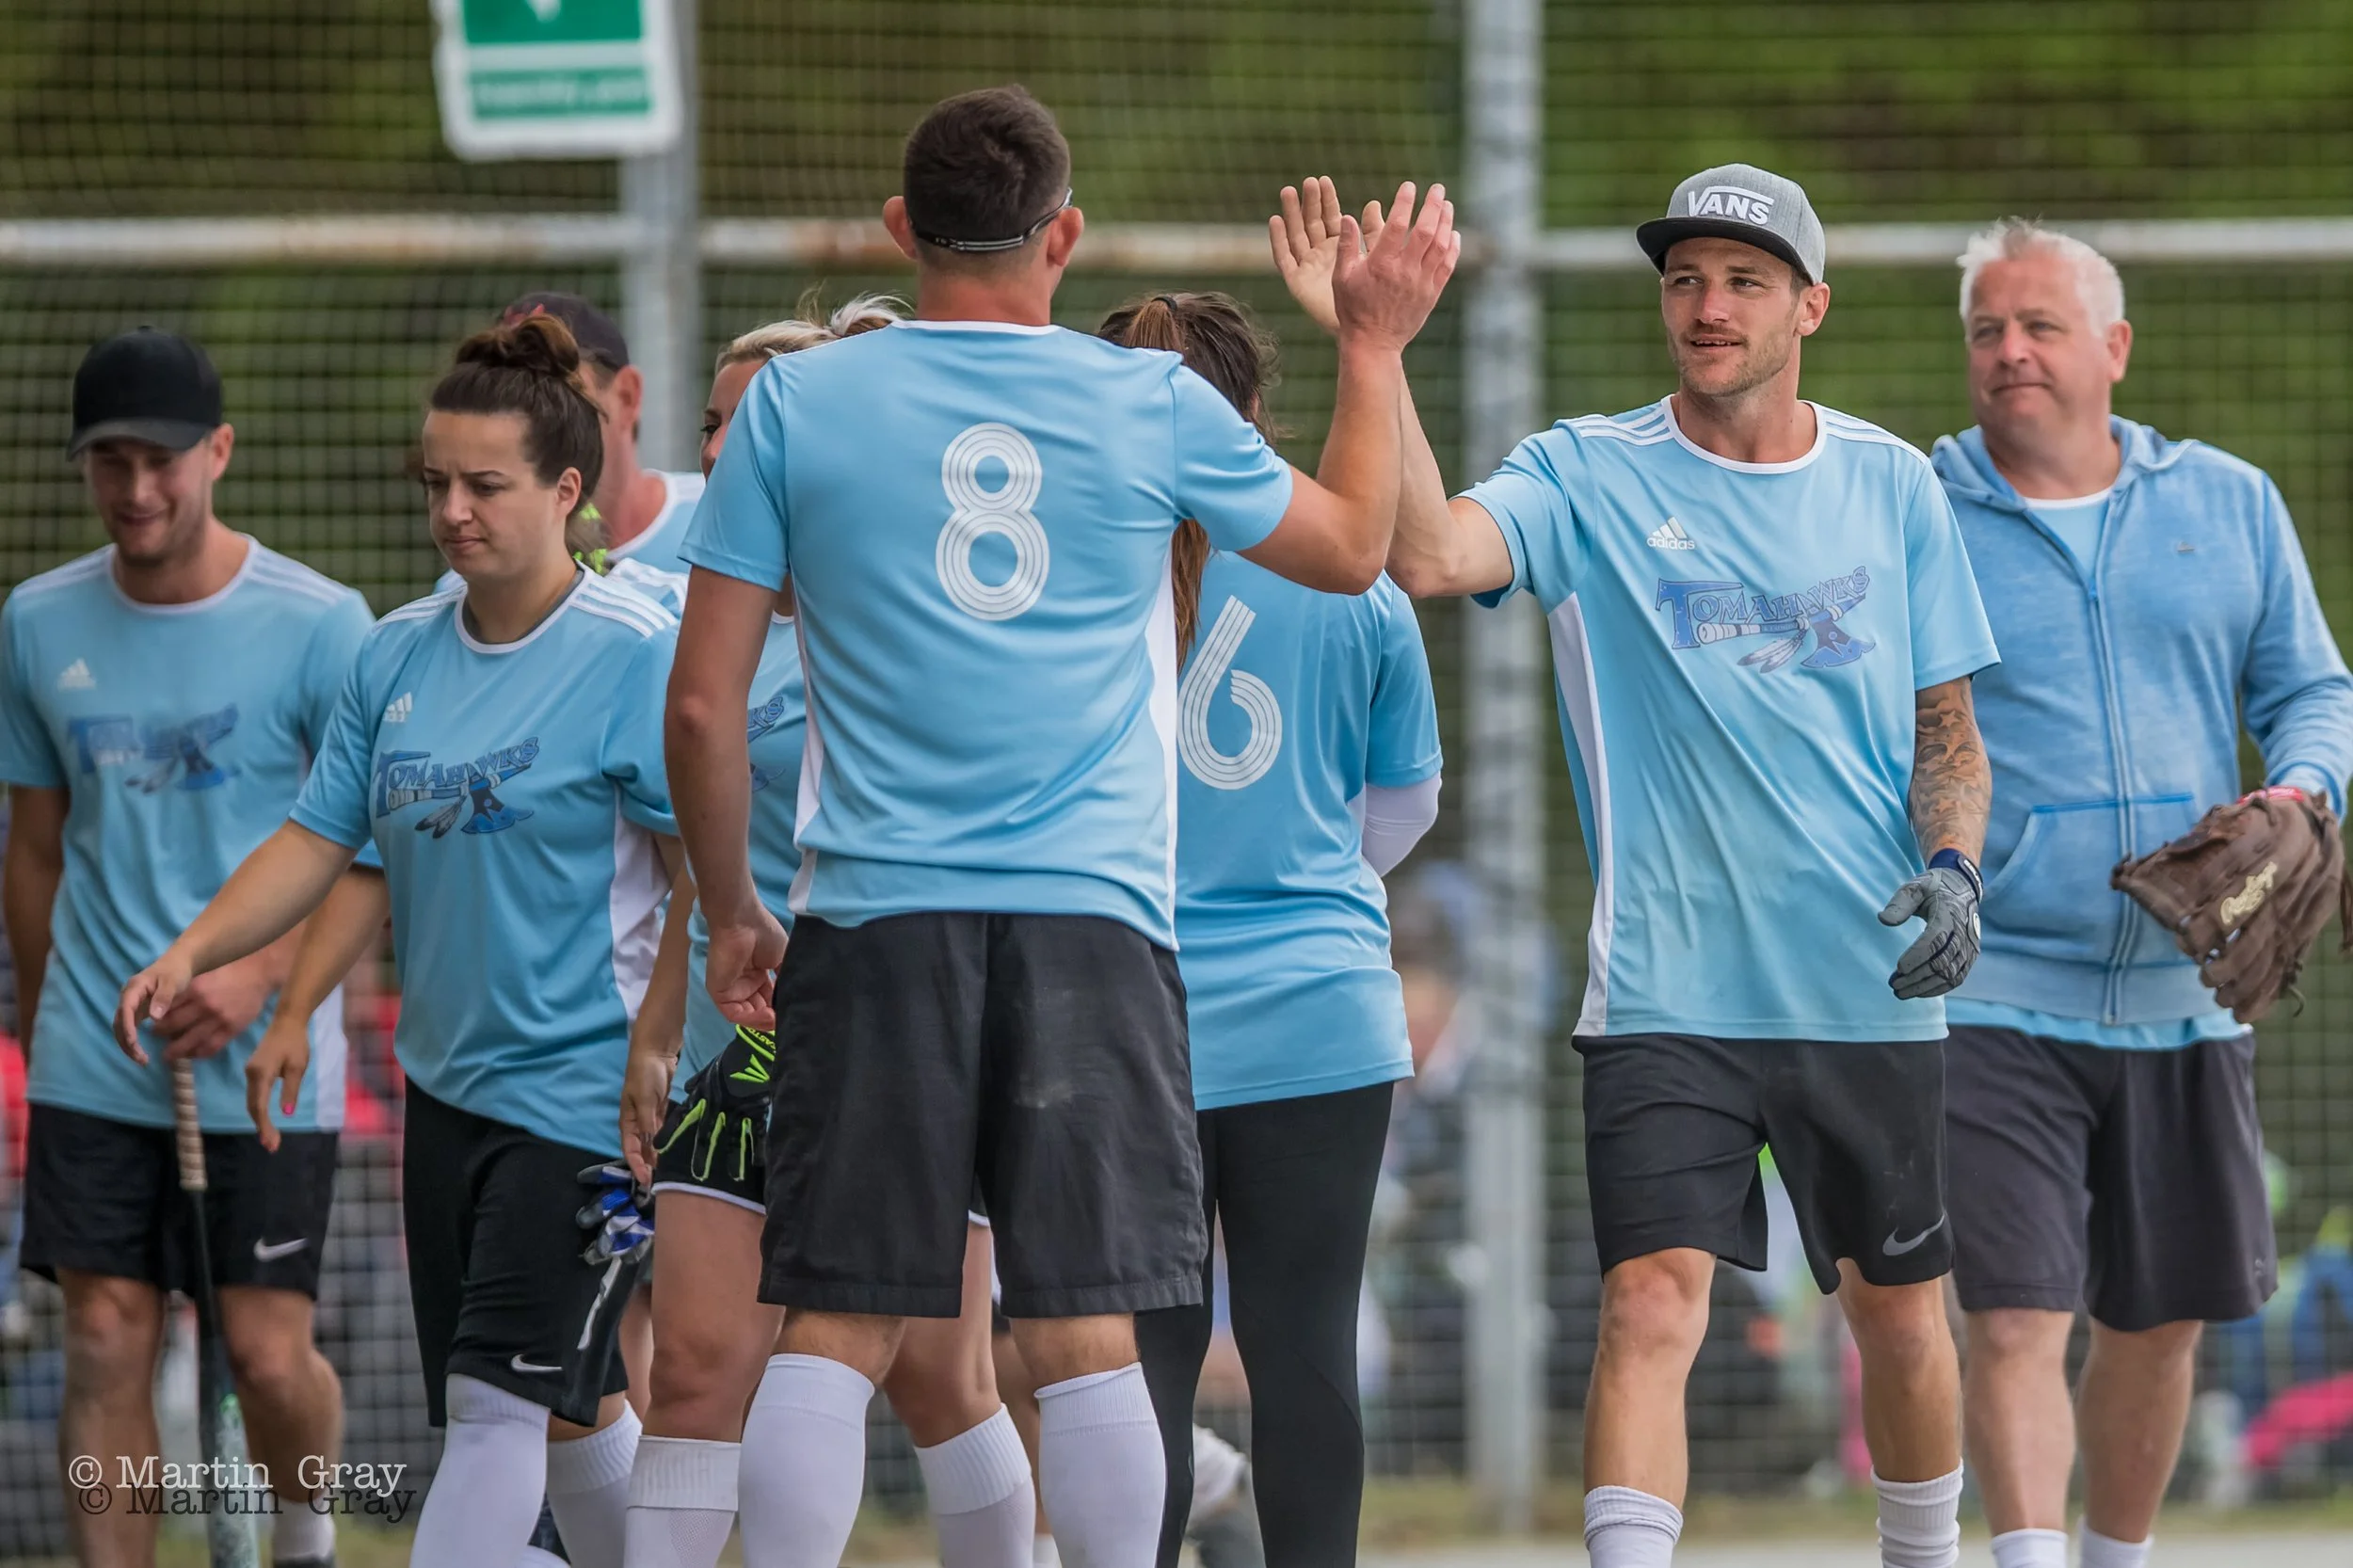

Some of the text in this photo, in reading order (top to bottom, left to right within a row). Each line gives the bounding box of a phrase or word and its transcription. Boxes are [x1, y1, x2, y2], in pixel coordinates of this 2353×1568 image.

[1688, 185, 1775, 226] VANS
[936, 422, 1050, 621] 8
[1646, 536, 1696, 551] adidas
[1655, 565, 1871, 650] TOMAHAWKS
[1176, 594, 1283, 790] 6
[373, 736, 540, 819] TOMAHAWKS
